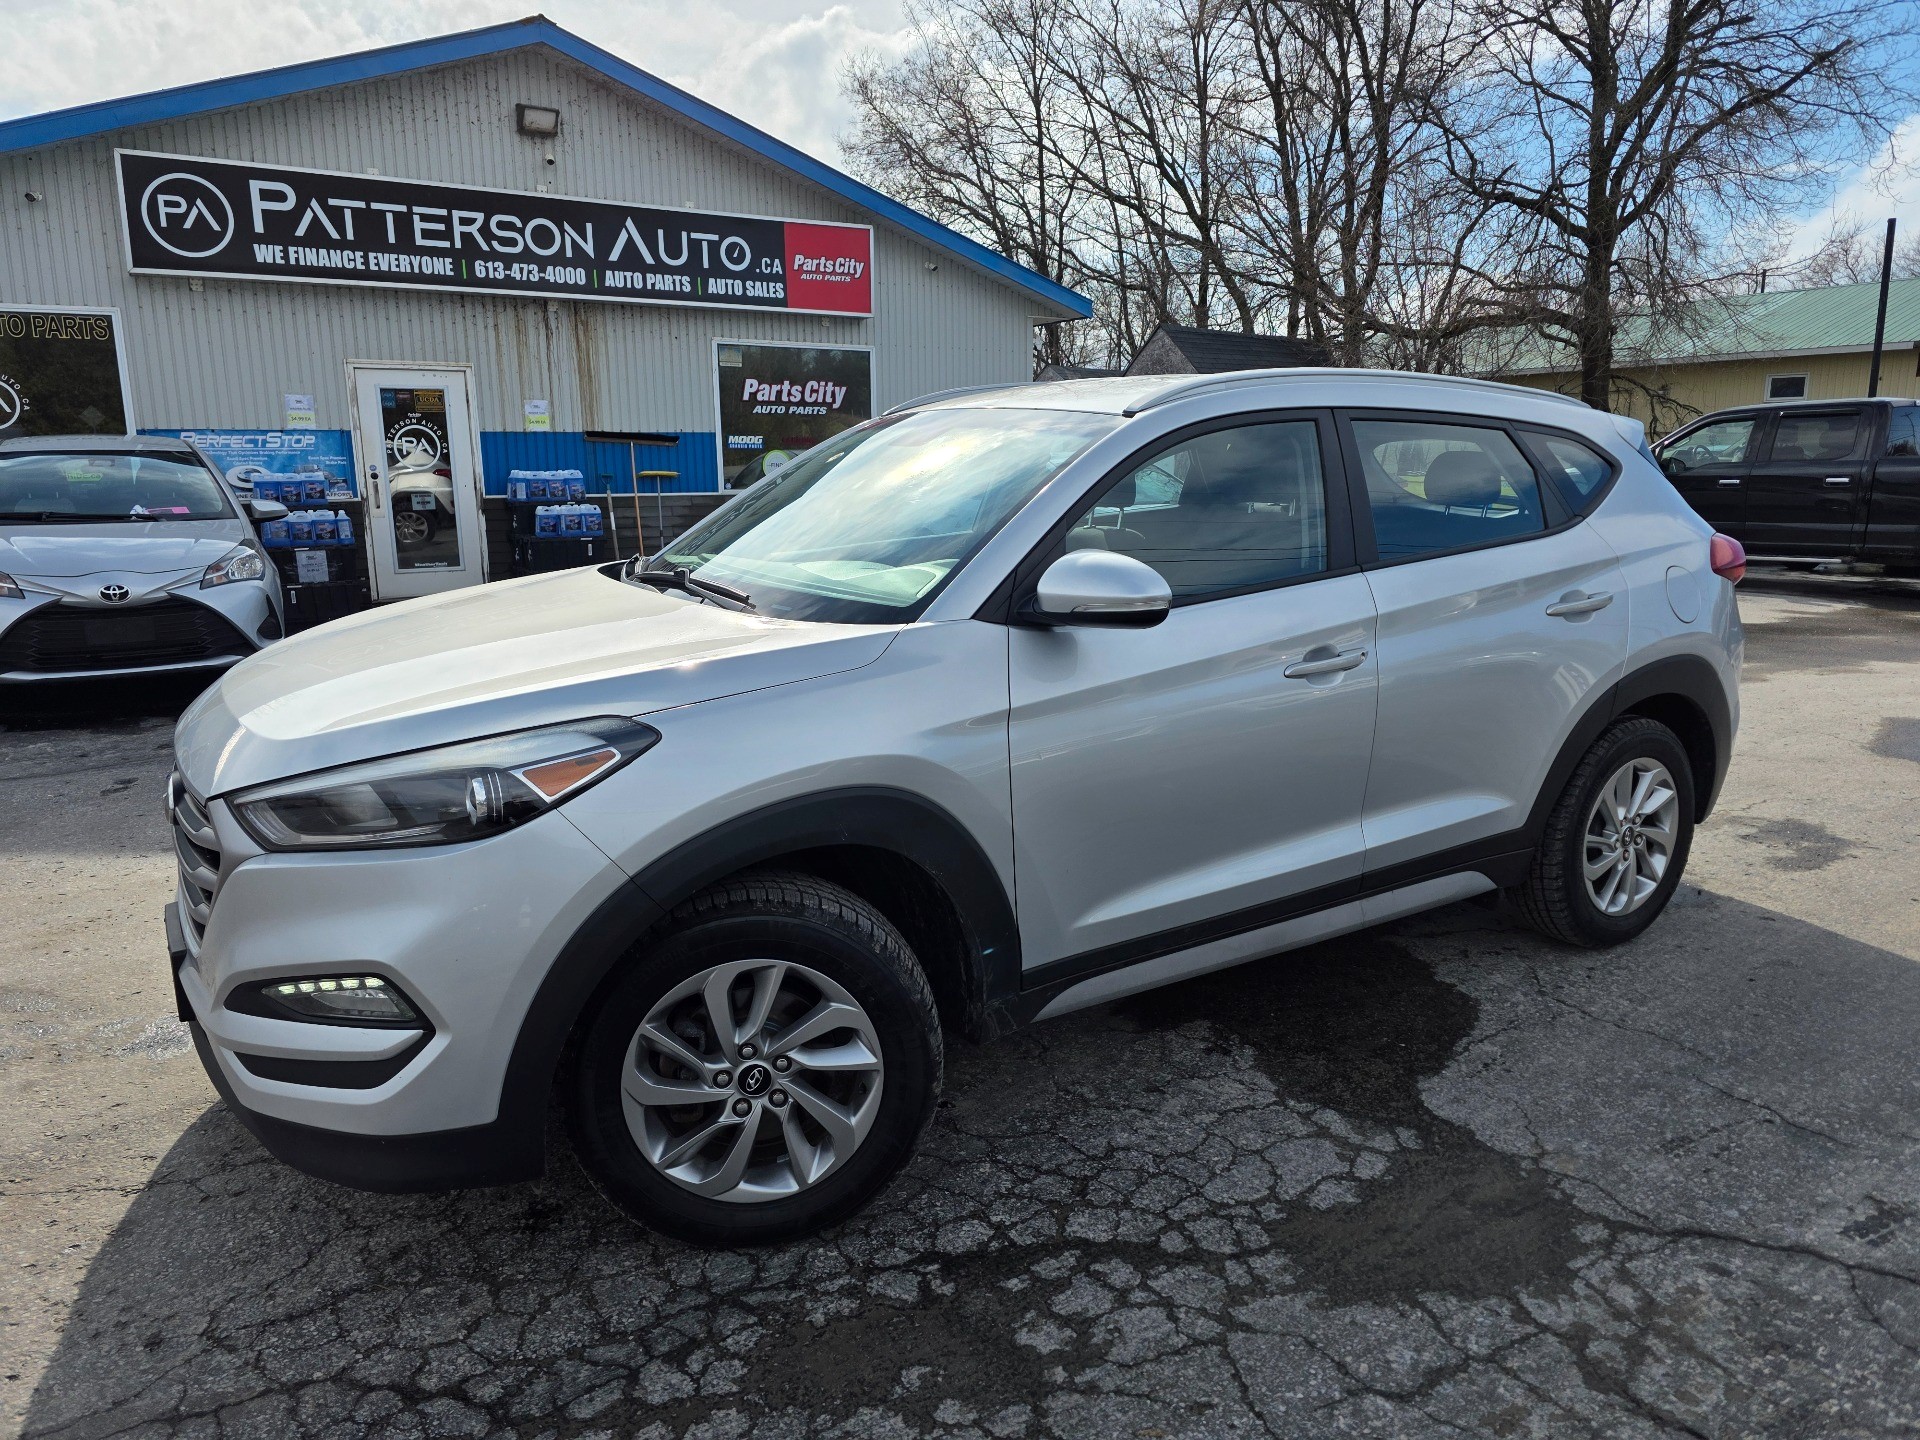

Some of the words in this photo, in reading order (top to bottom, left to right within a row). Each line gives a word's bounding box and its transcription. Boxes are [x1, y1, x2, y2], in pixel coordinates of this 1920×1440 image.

[156, 194, 222, 232] PA
[249, 179, 596, 259] PATTERSON
[608, 216, 752, 272] AUTO
[253, 243, 285, 264] WE
[289, 246, 366, 271] FINANCE
[369, 252, 455, 276] EVERYONE
[474, 259, 586, 286] 613-473-4000
[605, 270, 643, 289] AUTO
[646, 272, 691, 292] PARTS
[800, 273, 822, 281] AUTO
[824, 274, 851, 282] PARTS
[707, 278, 744, 297] AUTO
[745, 281, 785, 299] SALES
[31, 314, 109, 340] PARTS
[752, 405, 785, 414] AUTO
[788, 406, 827, 415] PARTS
[386, 418, 417, 454] PATTERSON
[421, 419, 442, 436] AUTO
[401, 437, 435, 455] PA
[728, 435, 763, 444] MOOG
